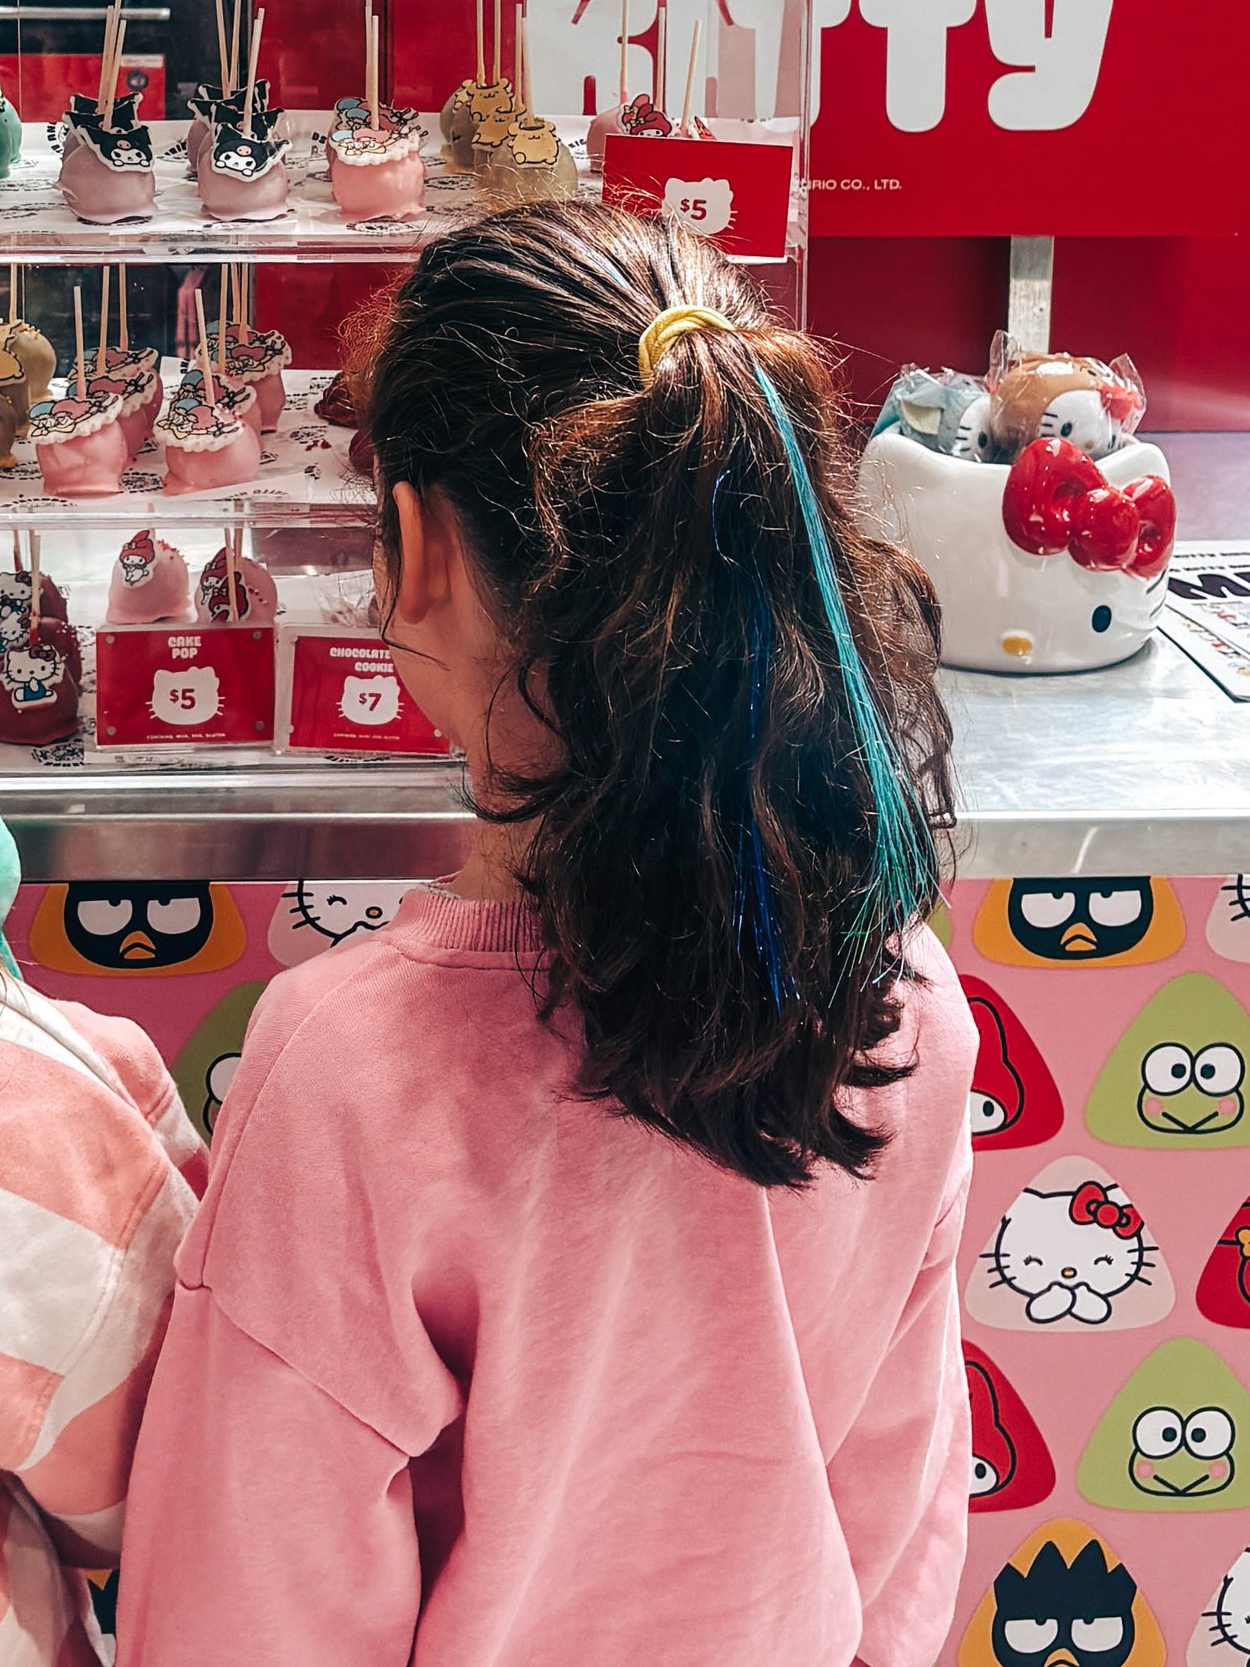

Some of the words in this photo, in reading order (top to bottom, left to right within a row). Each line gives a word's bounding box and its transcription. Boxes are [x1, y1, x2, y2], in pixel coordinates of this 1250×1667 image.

[874, 178, 902, 191] LTD.
[680, 198, 707, 221] $5
[168, 636, 202, 649] CAKE
[172, 648, 199, 660] POP
[329, 647, 392, 661] CHOCOLATE
[354, 661, 395, 673] COOKIE
[169, 688, 197, 711] $5
[358, 692, 383, 712] $7
